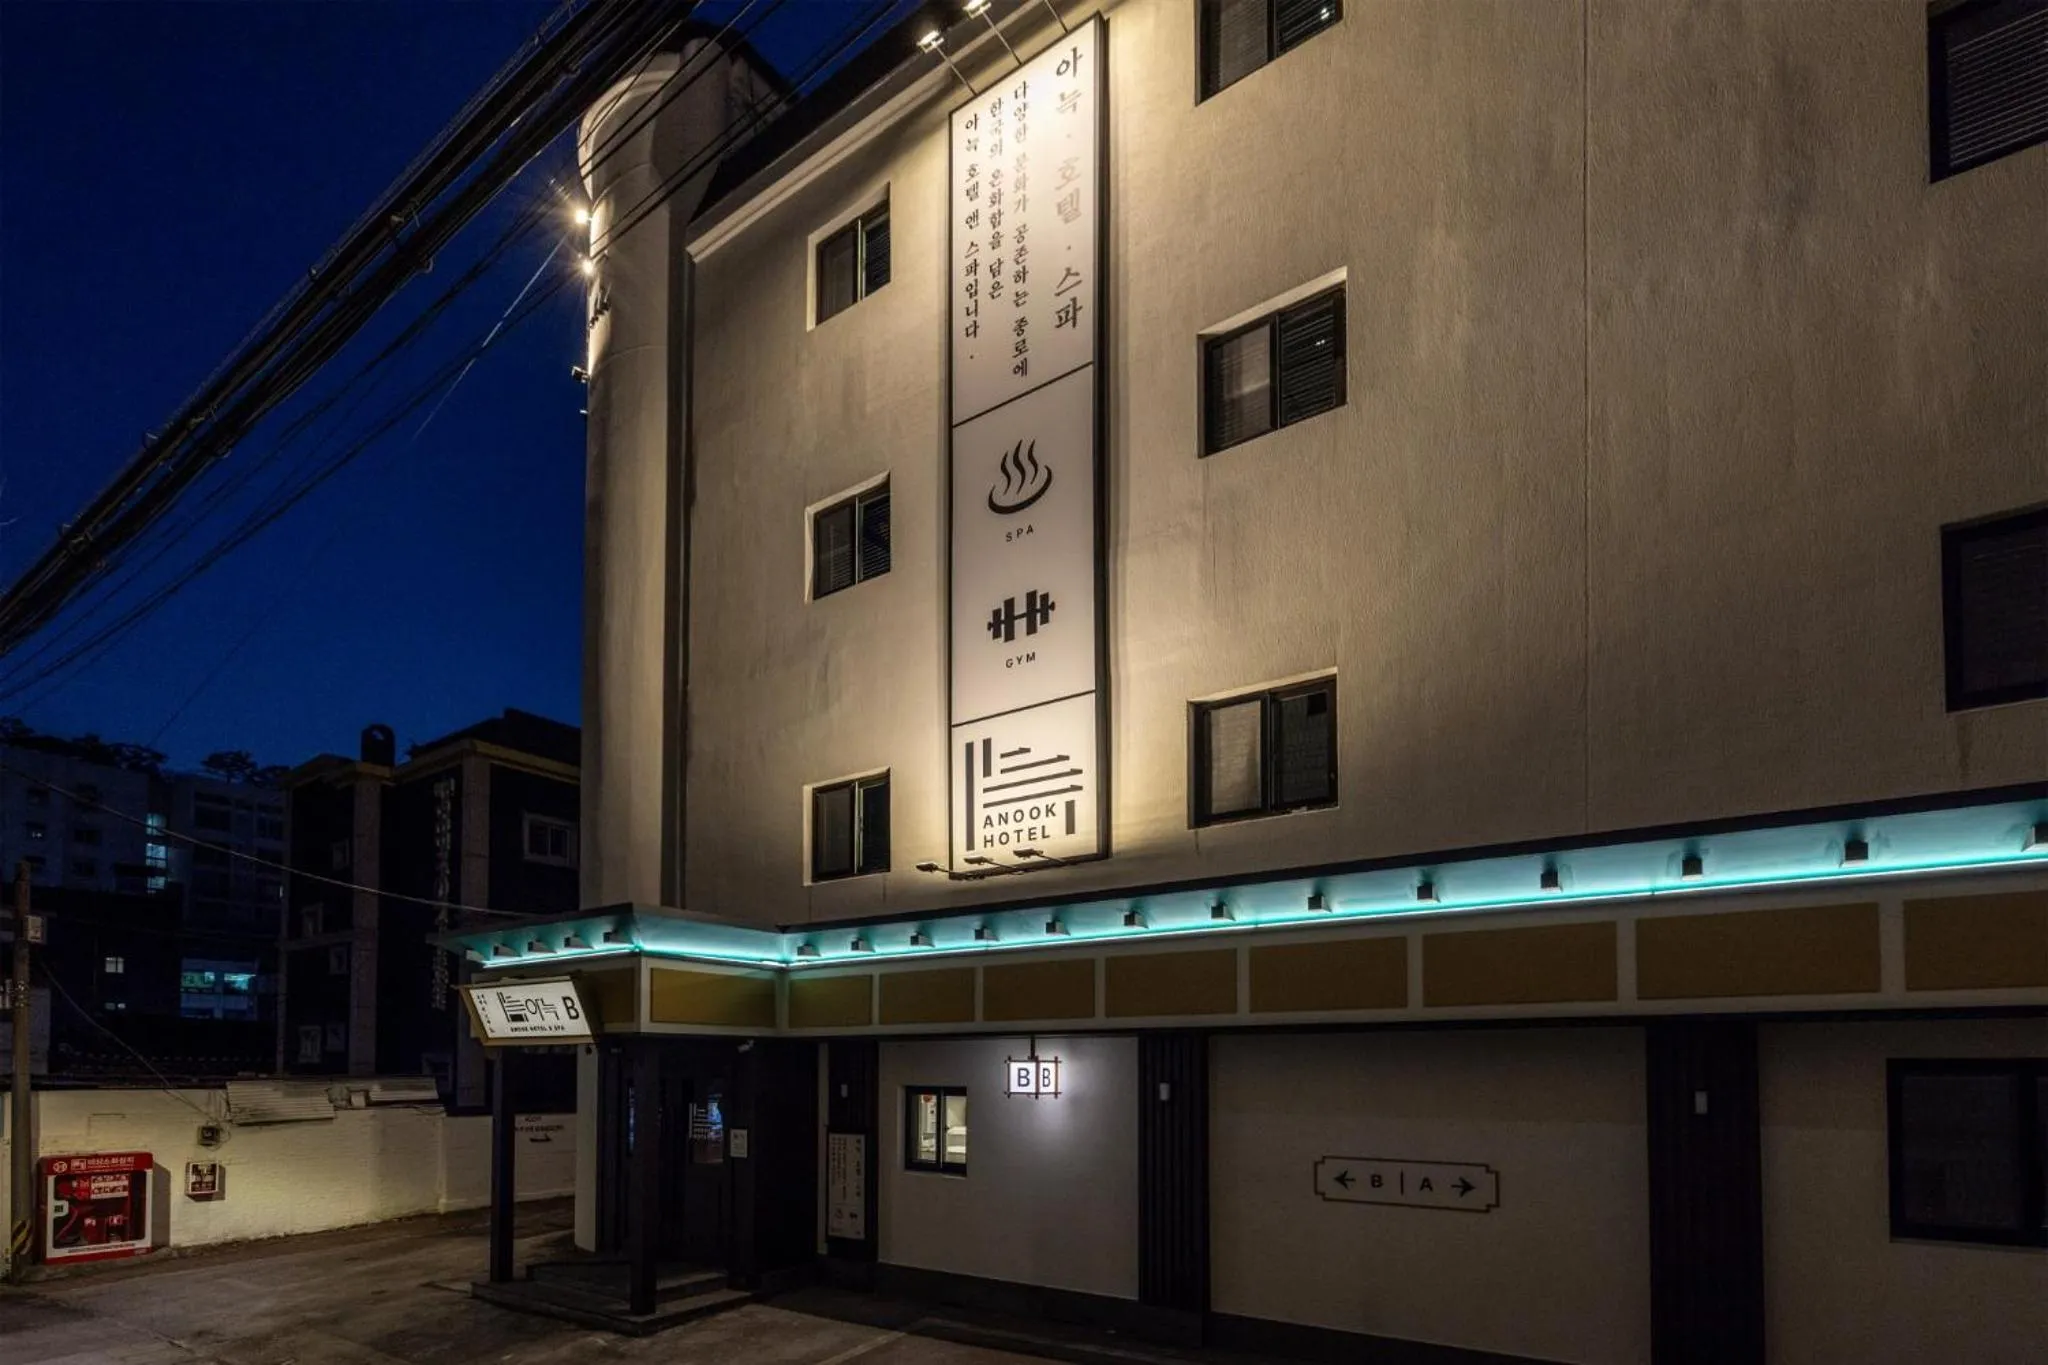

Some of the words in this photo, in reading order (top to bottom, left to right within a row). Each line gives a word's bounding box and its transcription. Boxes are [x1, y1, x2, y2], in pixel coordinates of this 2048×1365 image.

[1055, 45, 1084, 114] 아늑
[1013, 80, 1029, 144] 다양한
[1055, 156, 1082, 224] 호텔
[965, 209, 980, 230] 앤
[1012, 223, 1030, 308] 공존하는
[988, 258, 1004, 300] 담은
[1054, 266, 1083, 329] 스파
[1012, 316, 1030, 377] 종로에
[1005, 523, 1034, 543] SPA
[1005, 651, 1036, 668] GYM
[982, 802, 1057, 829] ANOOK
[984, 825, 1051, 848] HOTEL
[561, 996, 580, 1020] B
[1017, 1067, 1030, 1087] B
[1042, 1068, 1051, 1087] B
[1371, 1174, 1384, 1188] B
[1420, 1177, 1433, 1191] A
